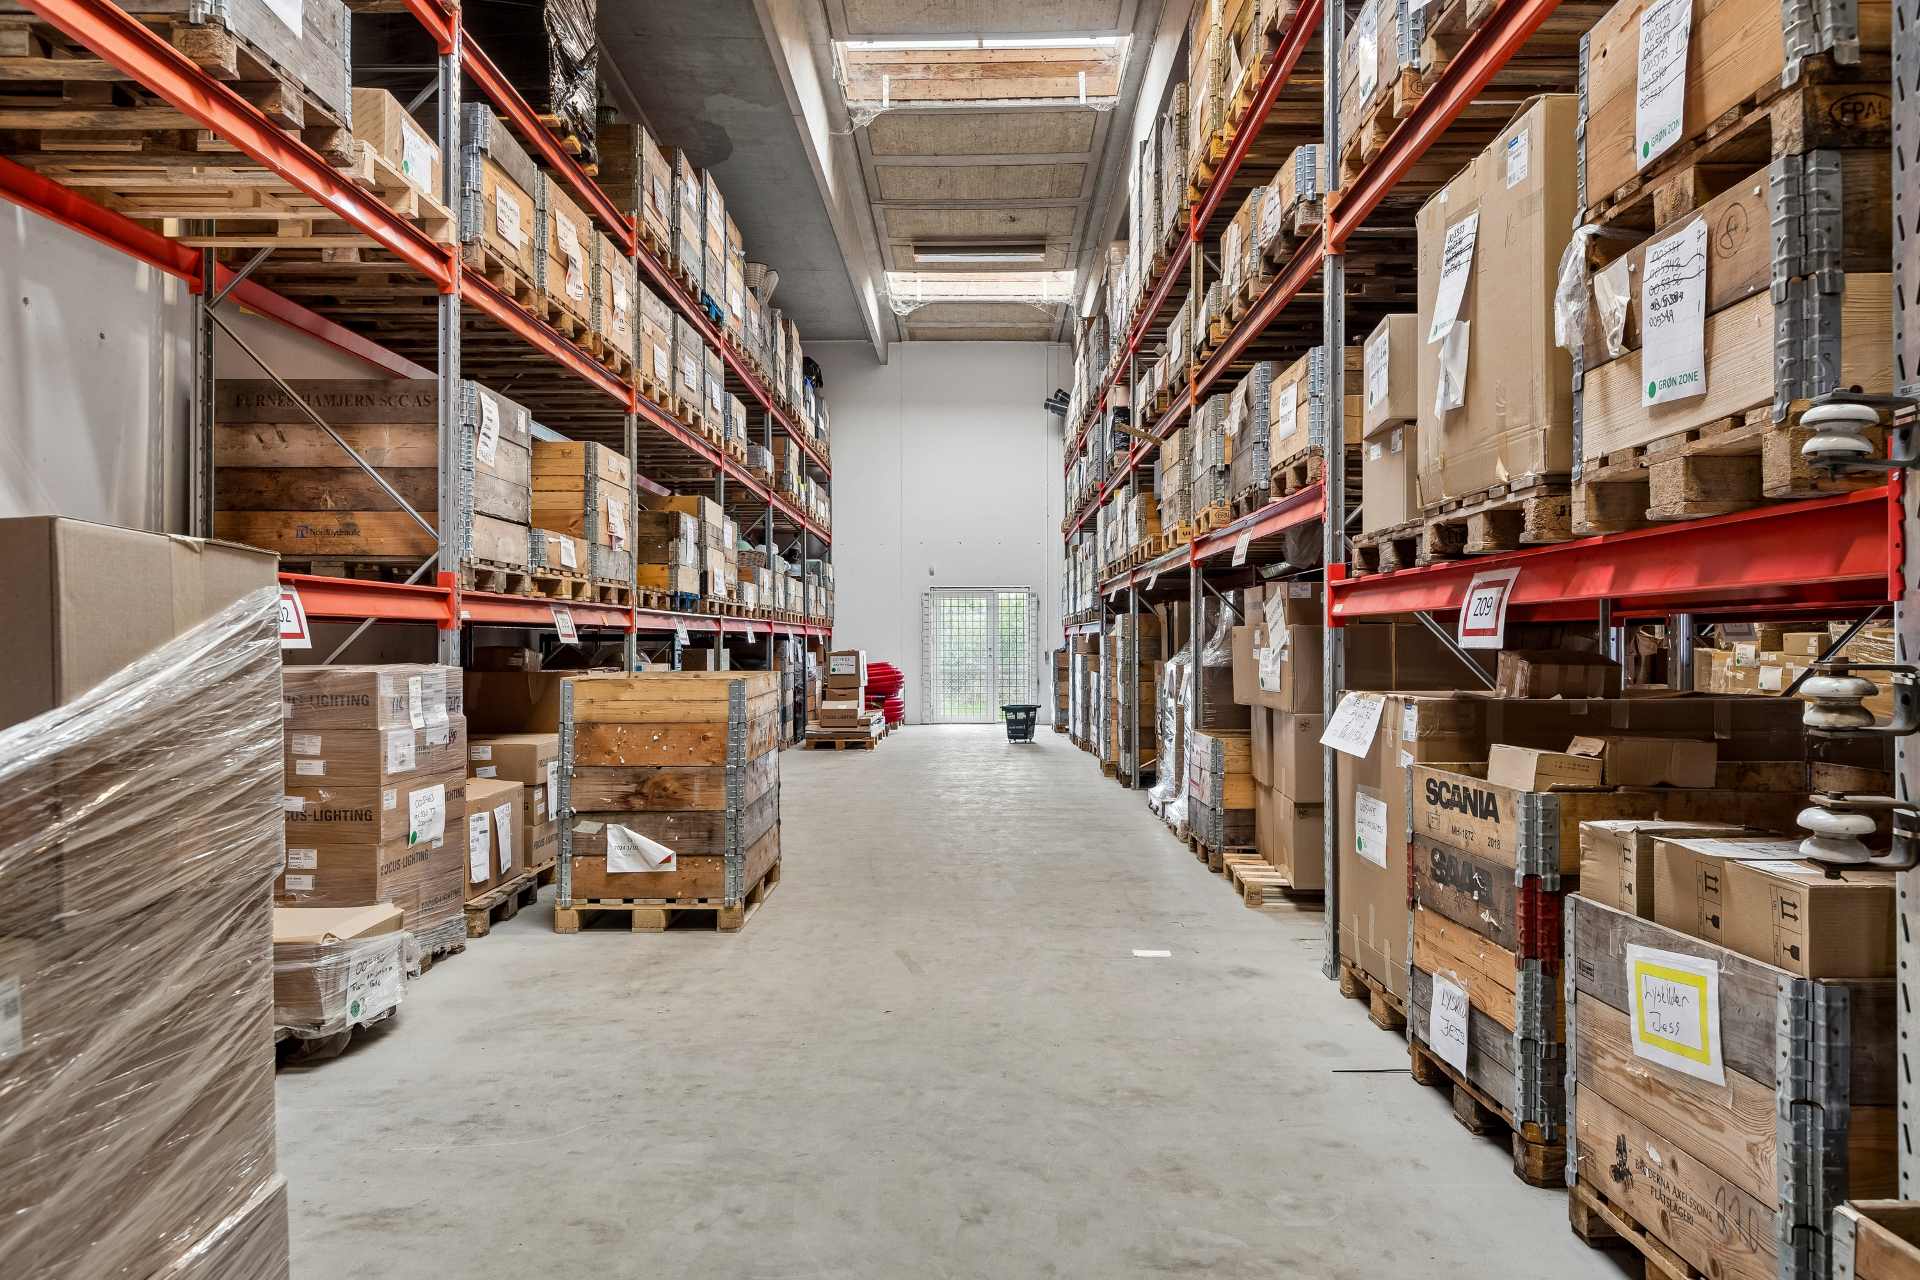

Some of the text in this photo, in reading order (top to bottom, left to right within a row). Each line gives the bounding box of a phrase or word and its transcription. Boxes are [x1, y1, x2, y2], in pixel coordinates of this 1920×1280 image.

[1658, 370, 1699, 391] GRØN ZONE
[1473, 596, 1493, 617] Z09
[1425, 777, 1501, 824] SCANIA
